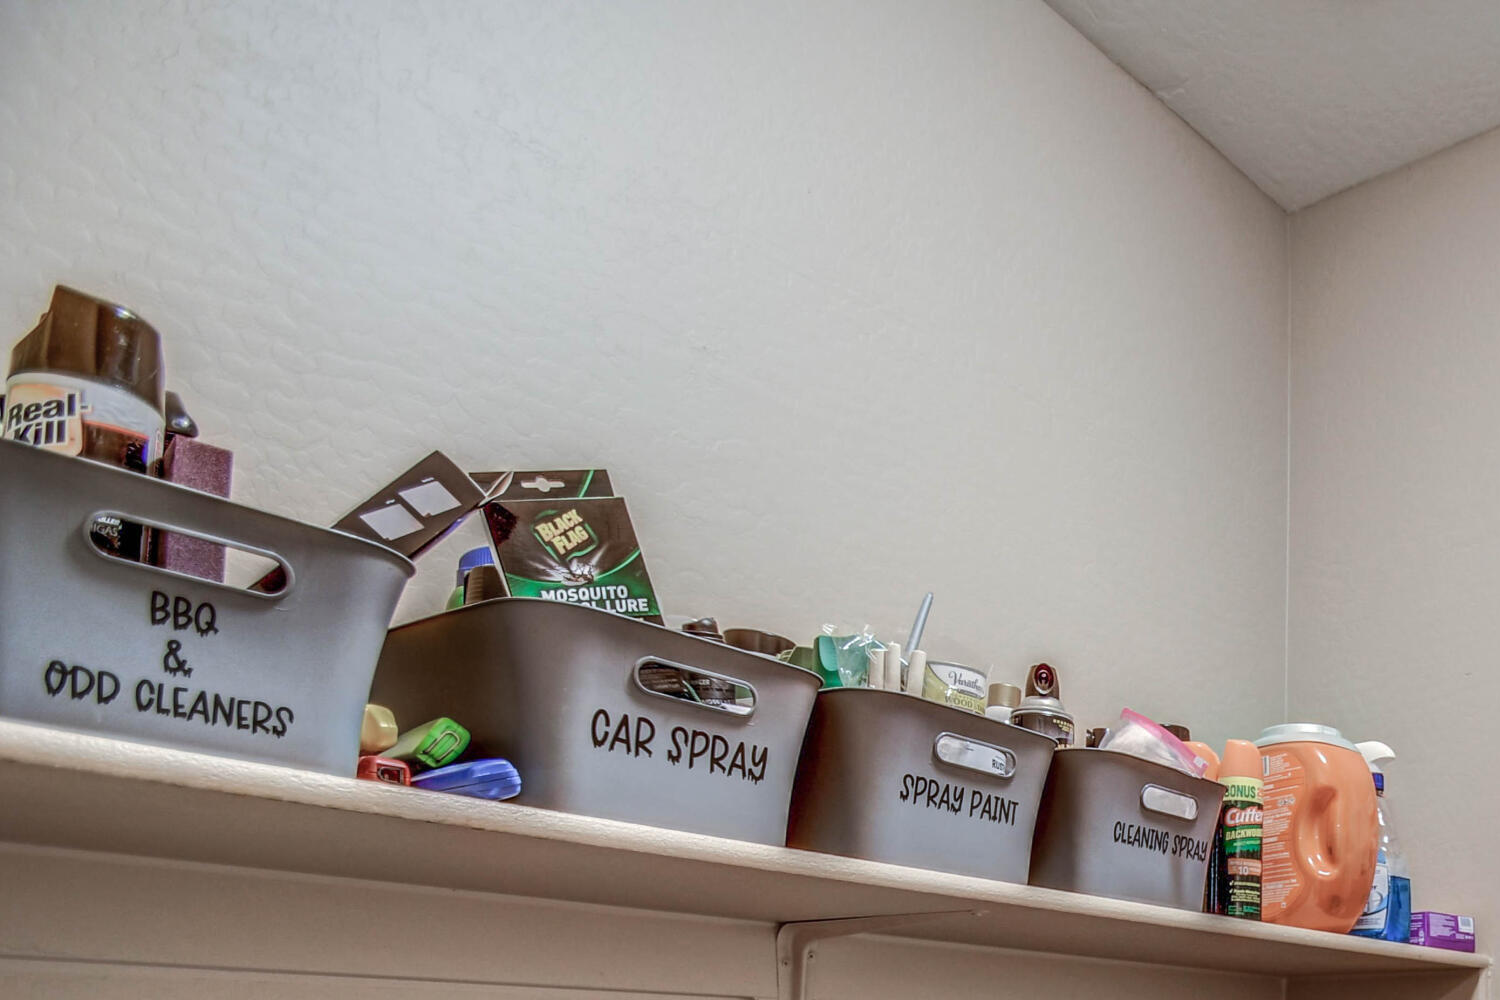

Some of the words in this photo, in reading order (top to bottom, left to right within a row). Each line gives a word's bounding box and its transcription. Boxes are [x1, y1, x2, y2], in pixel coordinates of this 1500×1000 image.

[535, 508, 584, 543] BLACK
[550, 525, 590, 556] FLAG
[149, 589, 219, 639] BBQ
[540, 585, 629, 602] MOSQUITO
[606, 597, 650, 614] LURE
[163, 638, 194, 679] &
[43, 659, 121, 705] ODD
[135, 677, 295, 738] CLEANERS
[590, 708, 656, 759] CAR
[666, 725, 769, 784] SPRAY
[899, 773, 965, 814] SPRAY
[969, 789, 1019, 827] PAINT
[1226, 806, 1263, 824] Cutte
[1112, 820, 1169, 856] CLEANING
[1171, 834, 1208, 863] SPRAY
